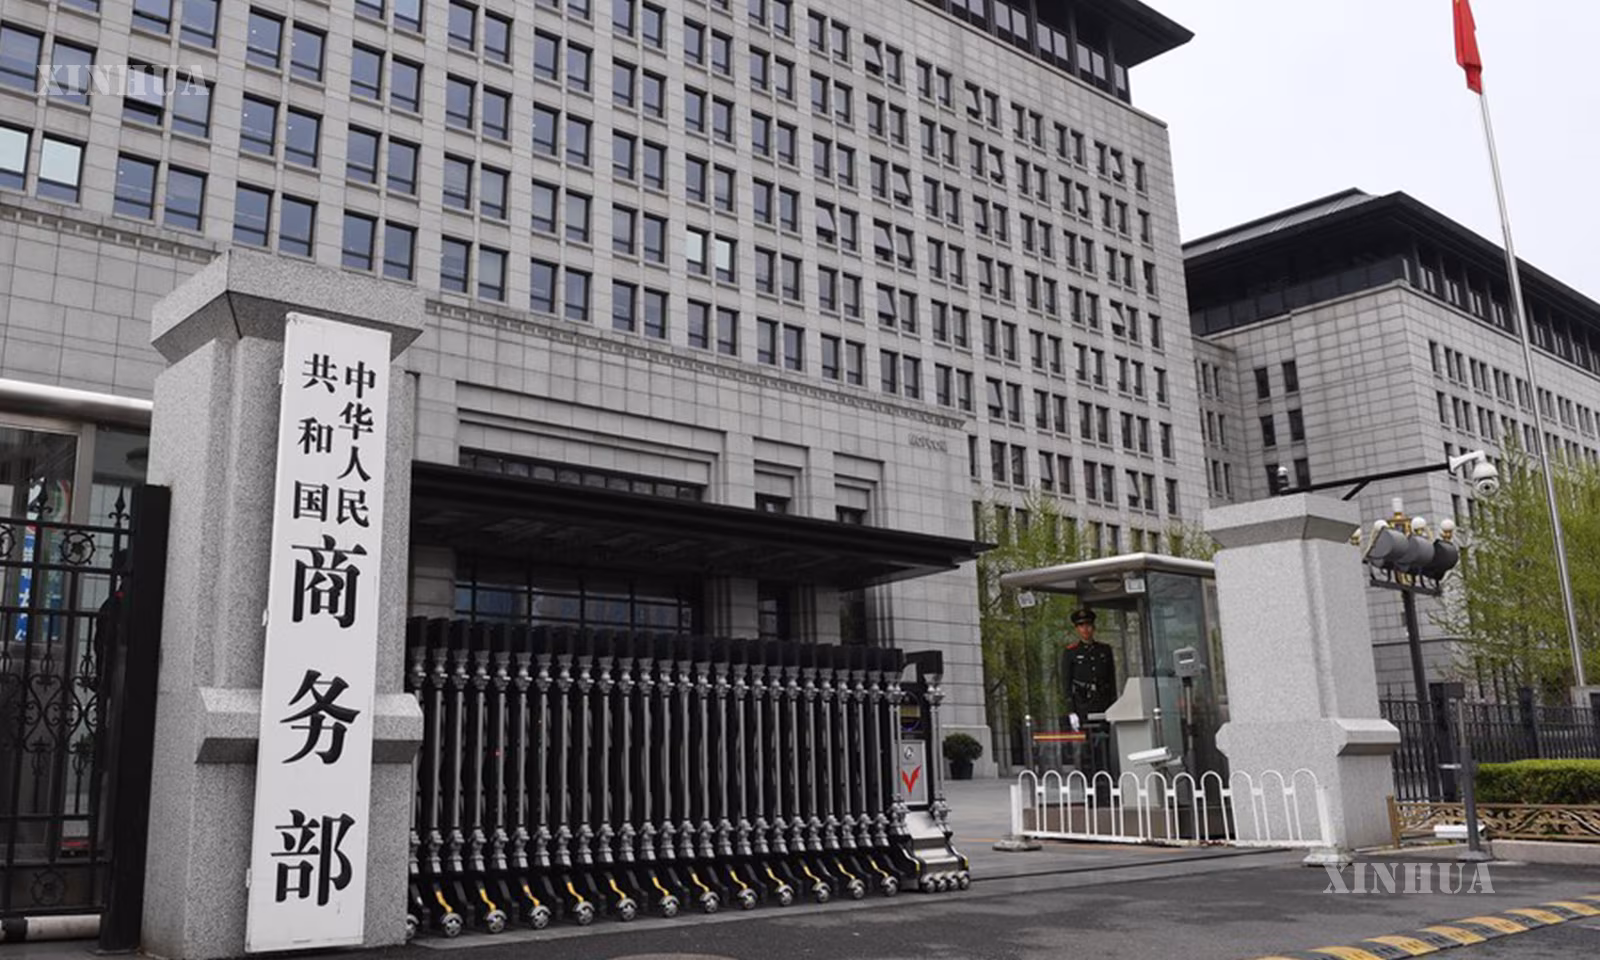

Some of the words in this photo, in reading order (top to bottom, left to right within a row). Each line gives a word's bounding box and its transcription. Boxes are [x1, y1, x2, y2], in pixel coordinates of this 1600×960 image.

[293, 353, 338, 522] 共和国
[336, 361, 376, 528] 中华人民
[271, 534, 368, 907] 商务部
